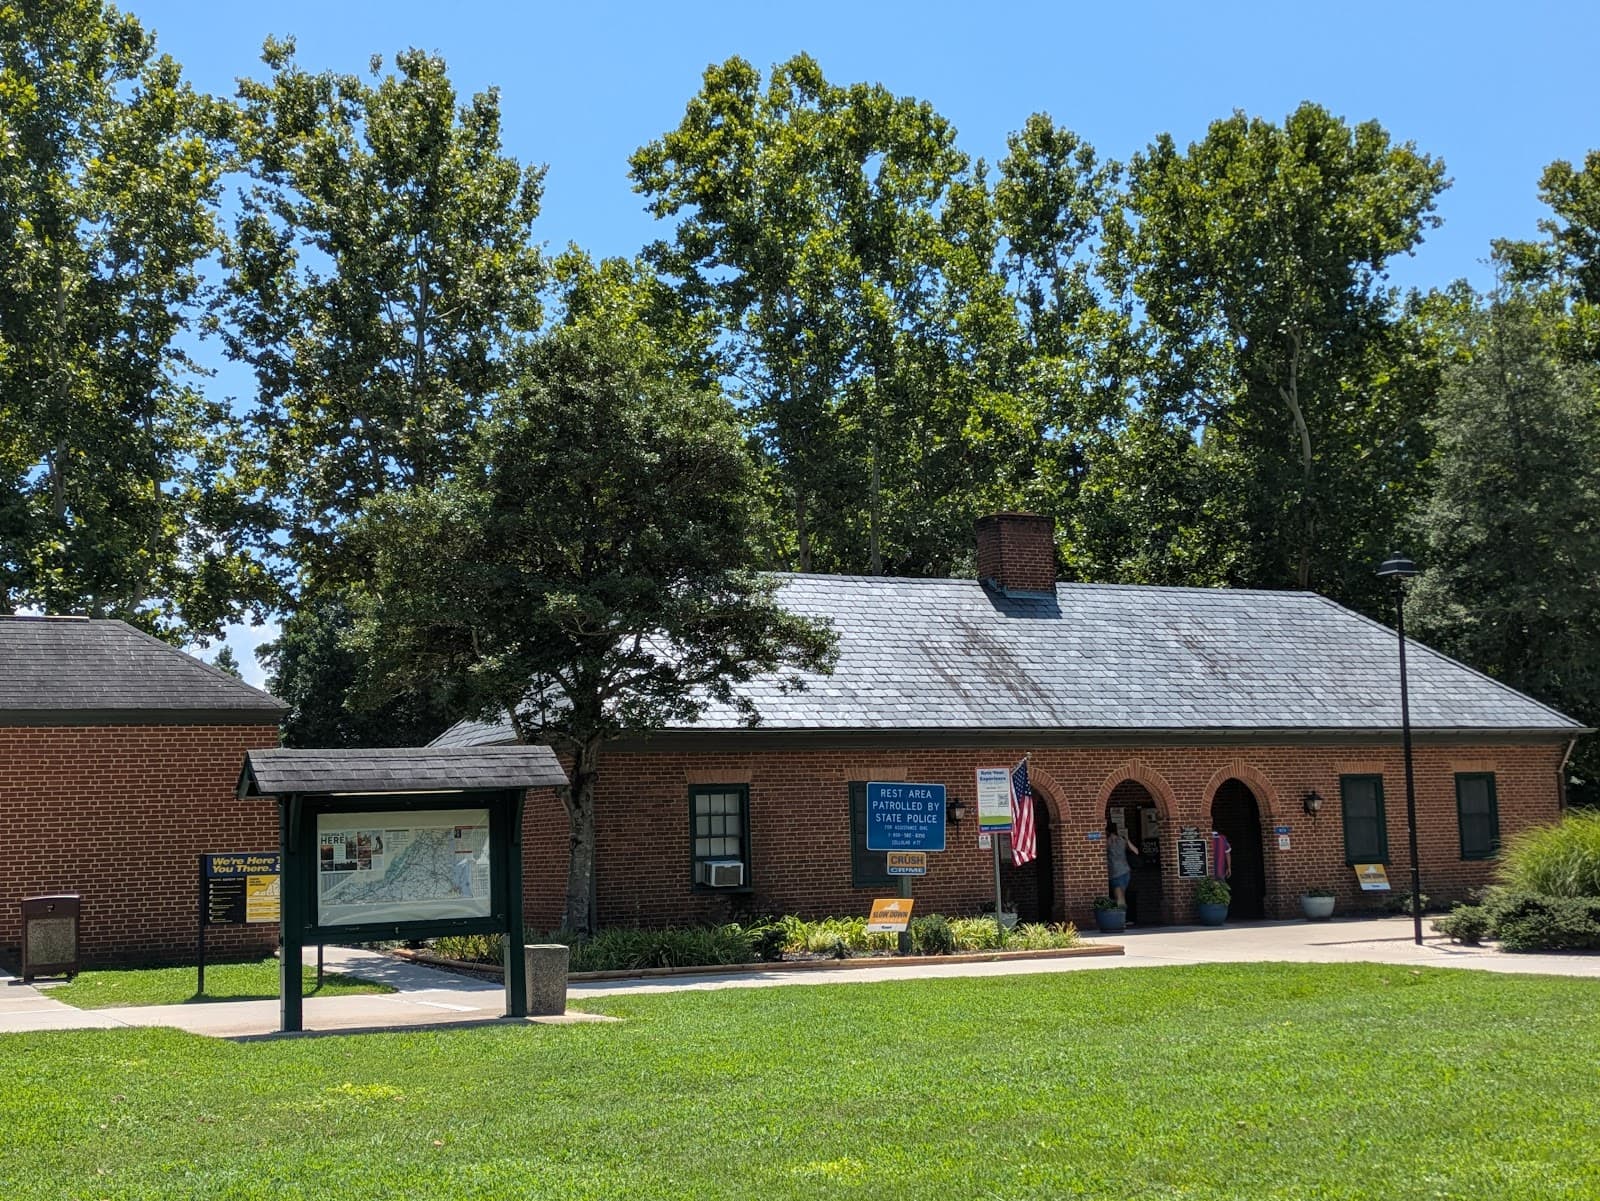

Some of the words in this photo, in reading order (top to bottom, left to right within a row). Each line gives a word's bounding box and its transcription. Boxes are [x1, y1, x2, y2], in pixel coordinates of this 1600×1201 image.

[880, 788, 903, 798] REST
[908, 789, 932, 799] AREA
[872, 800, 923, 811] PATROLLED
[927, 802, 940, 811] BY
[875, 813, 902, 823] STATE
[907, 813, 937, 824] POLICE
[320, 836, 345, 845] HERE
[212, 857, 245, 866] We're
[246, 856, 275, 865] Here
[890, 855, 924, 865] CRUSH
[212, 865, 234, 874] You
[236, 864, 272, 873] There.
